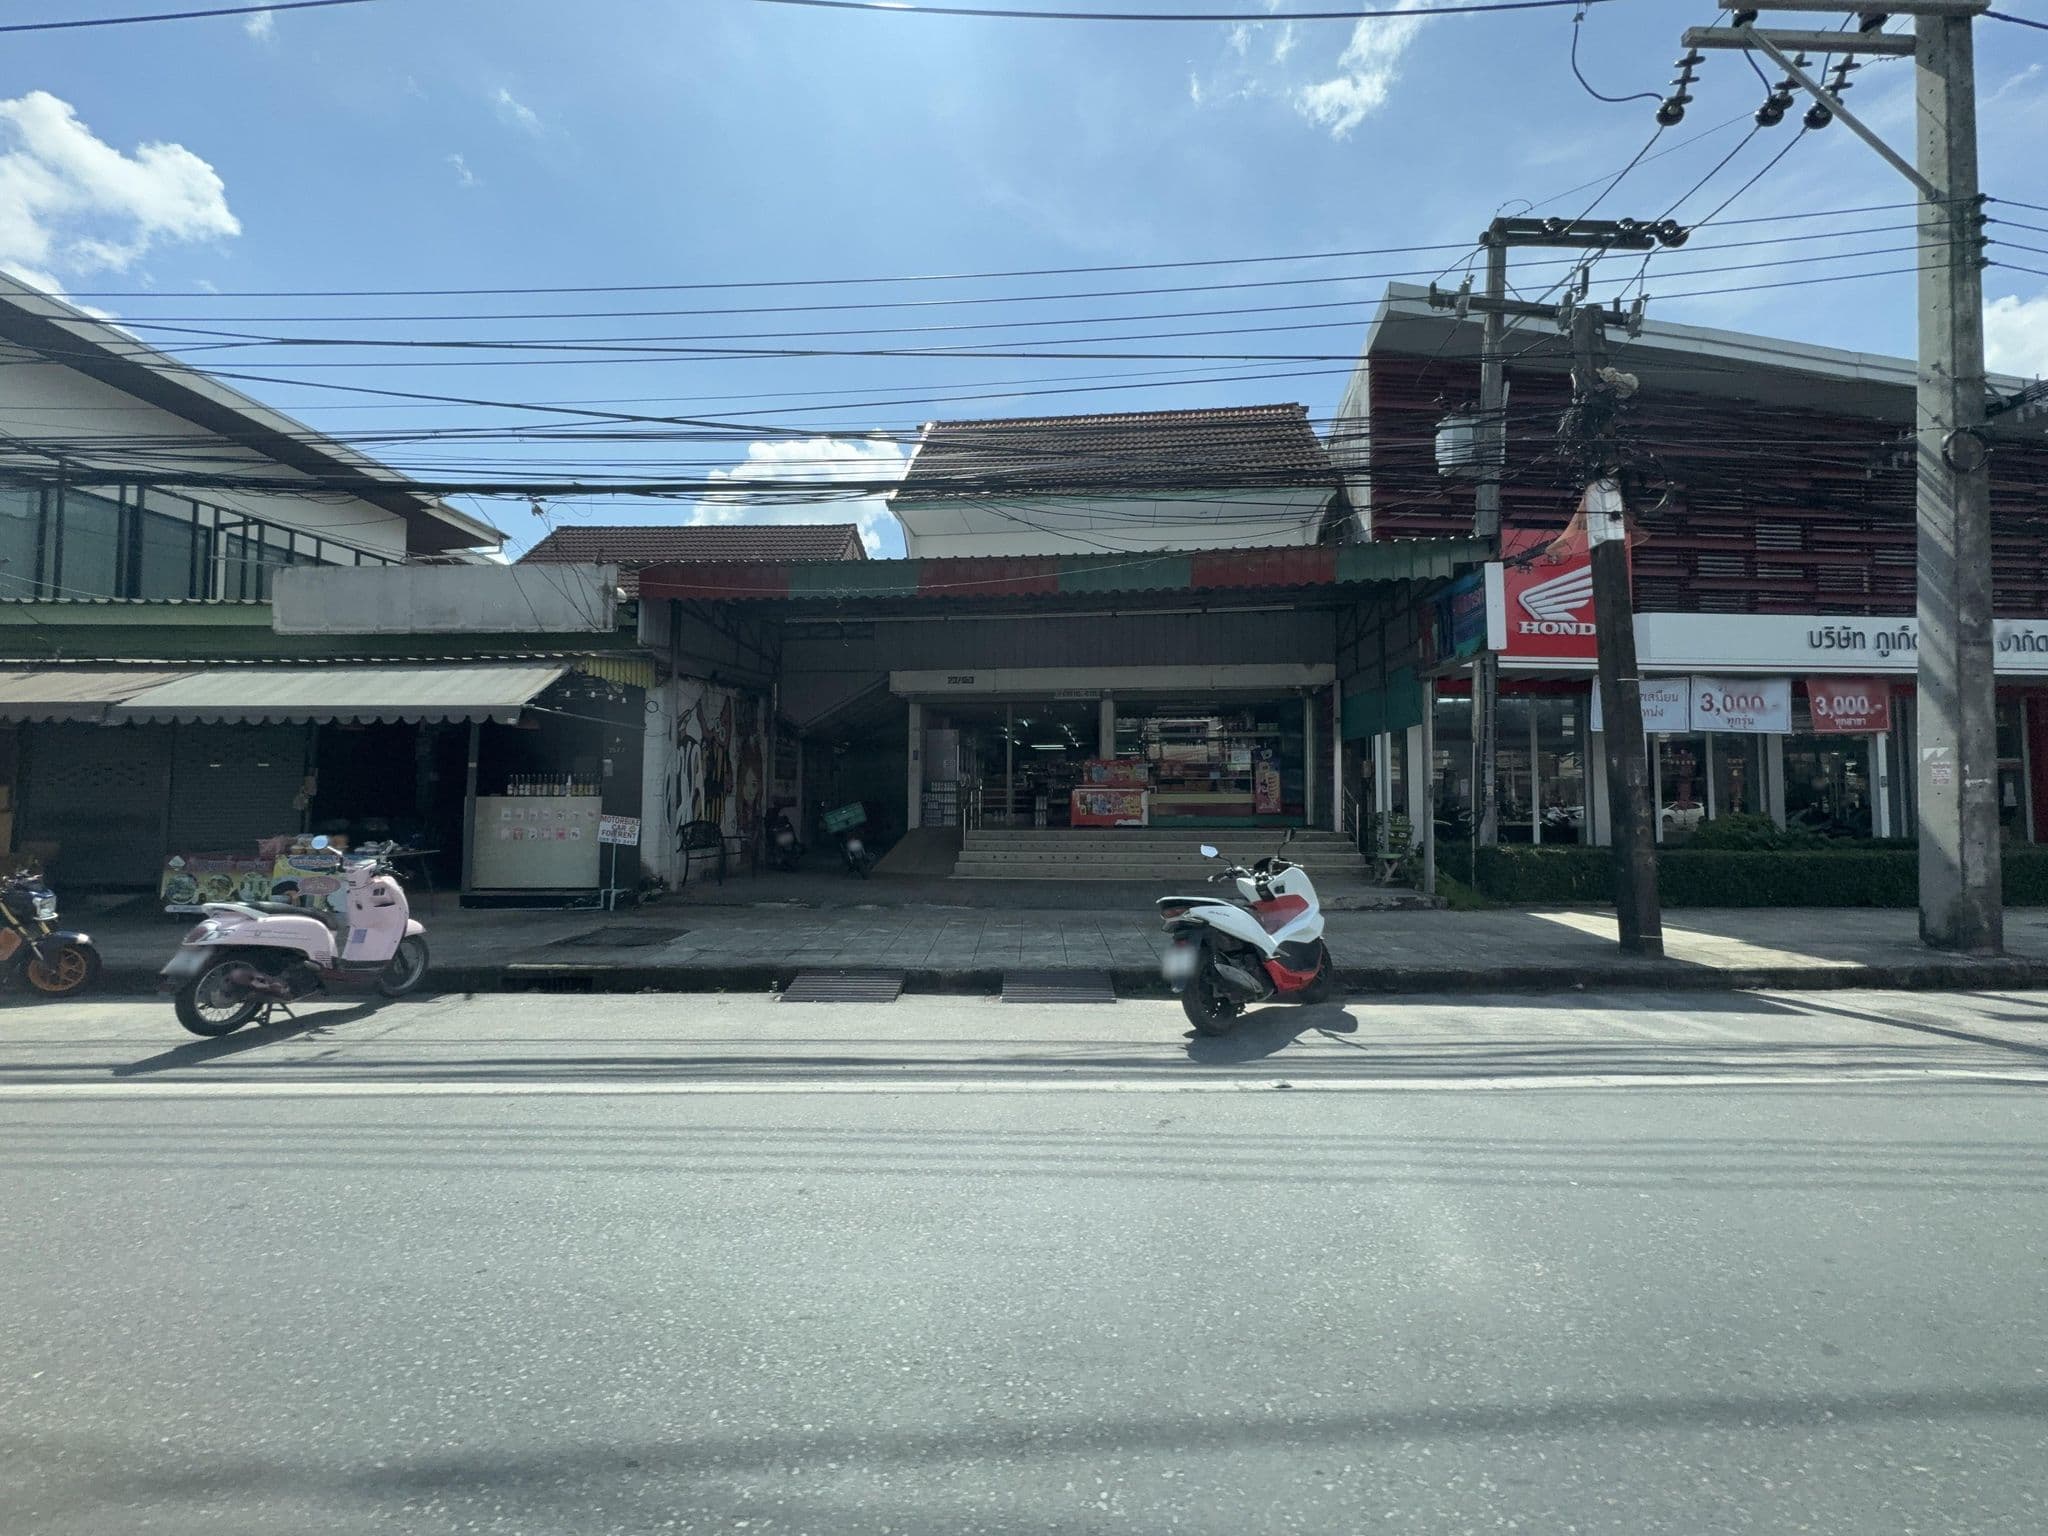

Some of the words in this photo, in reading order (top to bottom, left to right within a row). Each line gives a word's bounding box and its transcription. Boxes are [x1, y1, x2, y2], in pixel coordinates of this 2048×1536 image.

[1519, 621, 1596, 635] HOND
[1808, 625, 1866, 649] บริษัท
